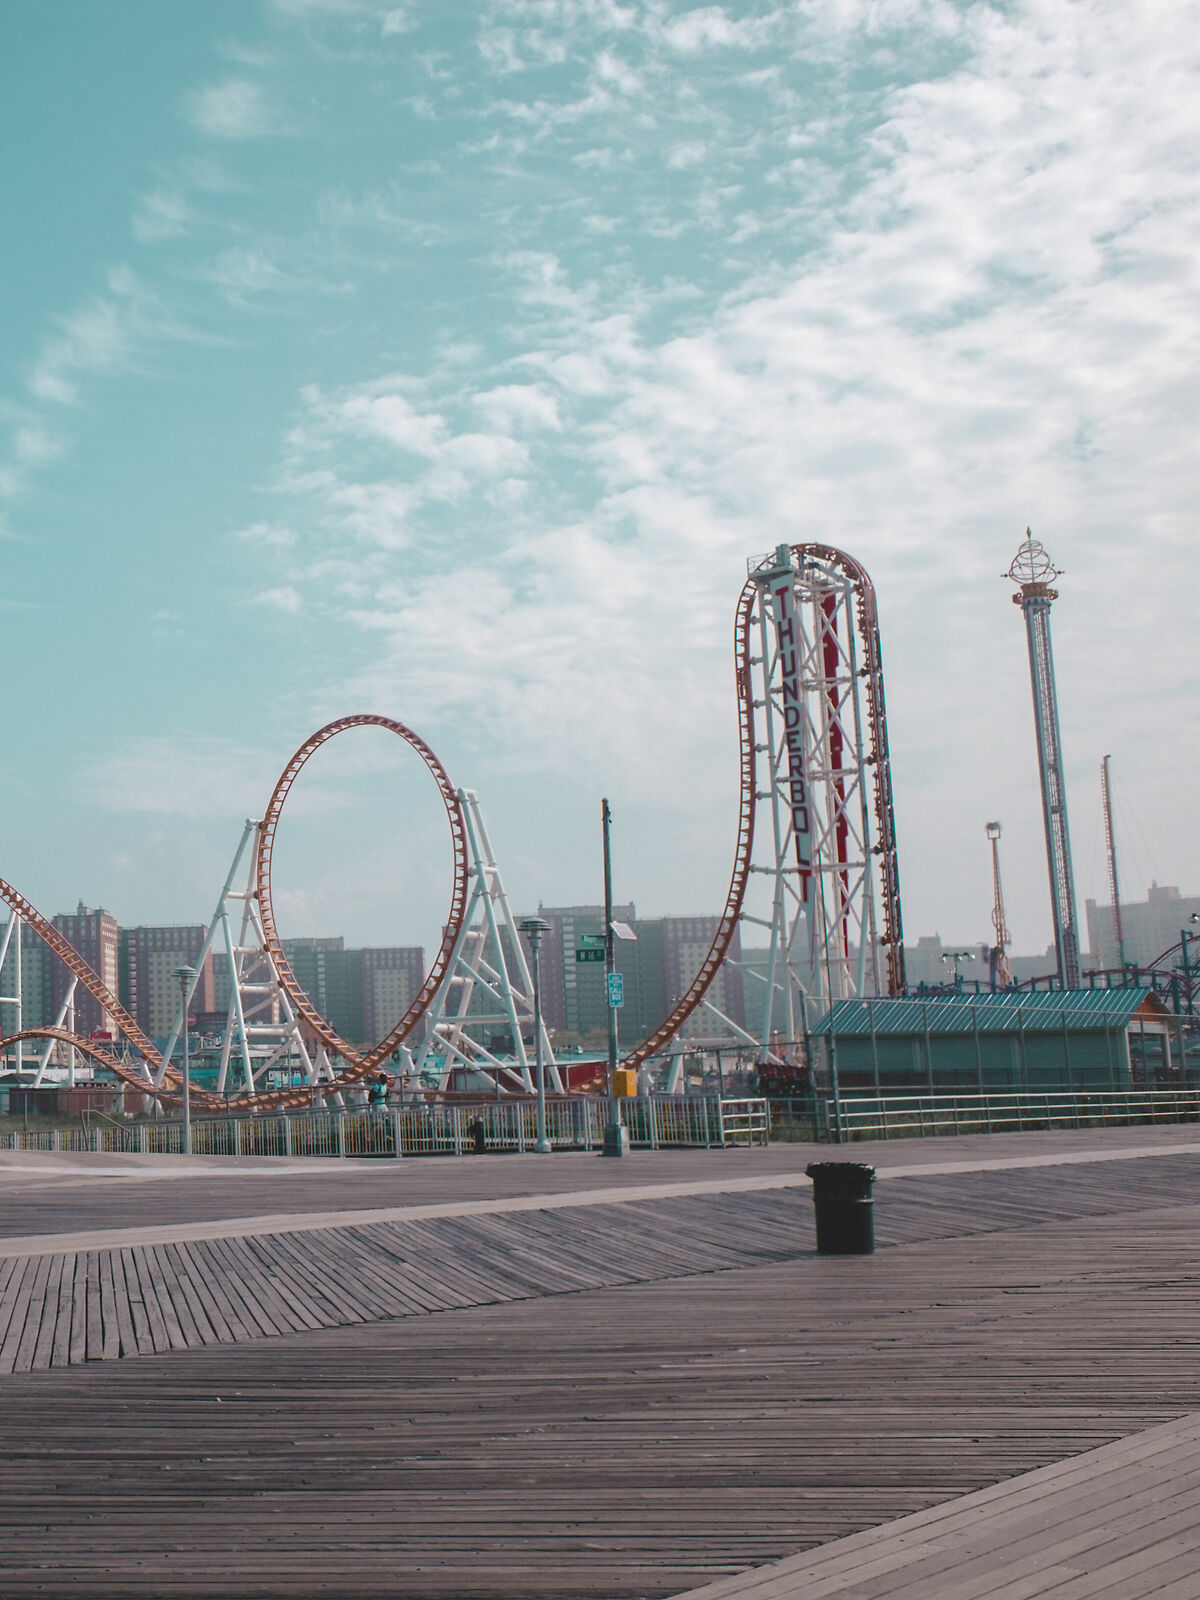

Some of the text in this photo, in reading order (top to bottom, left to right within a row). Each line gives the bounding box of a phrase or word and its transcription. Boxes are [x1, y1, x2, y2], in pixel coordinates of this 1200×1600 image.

[774, 585, 812, 903] THUNDERBOLT
[579, 951, 585, 960] W
[588, 951, 595, 960] 16
